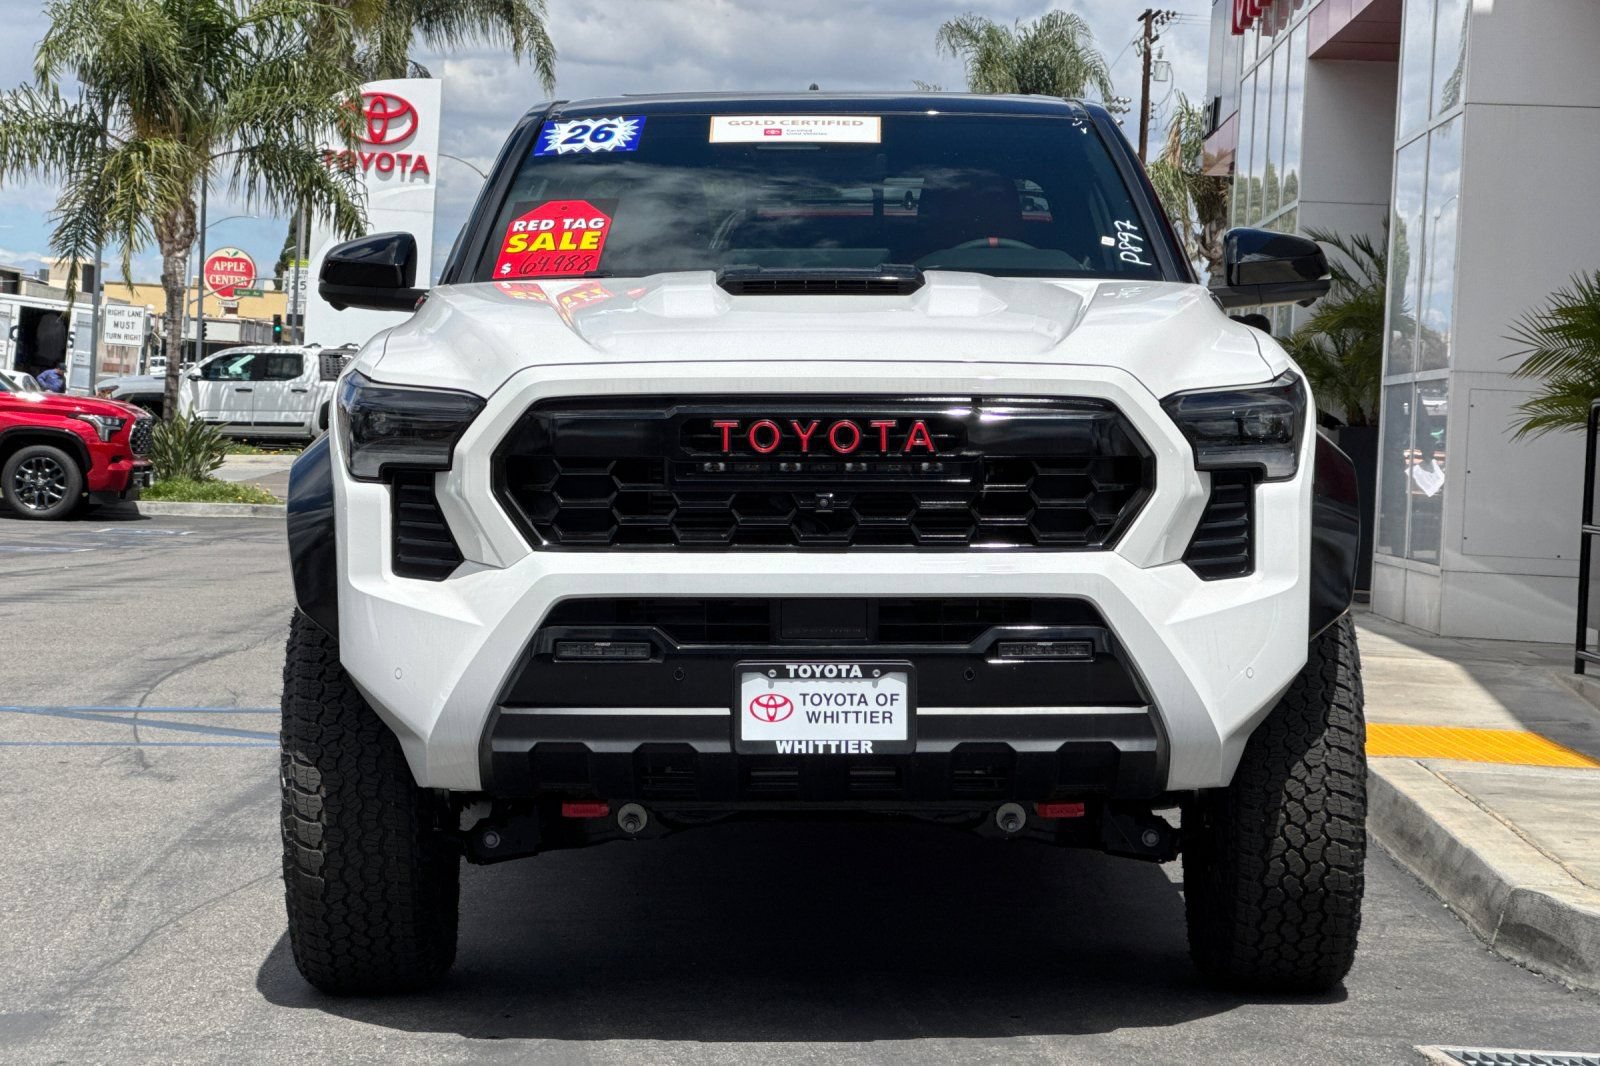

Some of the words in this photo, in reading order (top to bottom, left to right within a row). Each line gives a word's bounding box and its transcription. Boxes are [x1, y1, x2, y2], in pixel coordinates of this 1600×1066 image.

[559, 123, 619, 145] 26
[512, 219, 555, 232] RED
[562, 217, 605, 230] TAG
[505, 230, 601, 253] SALE
[213, 261, 246, 272] APPLE
[500, 260, 512, 274] $
[209, 274, 248, 286] CENTER
[107, 308, 125, 316] RIGHT
[128, 309, 142, 318] LANE
[113, 320, 136, 330] MUST
[105, 332, 122, 340] TURN
[123, 333, 142, 341] RIGHT
[712, 419, 936, 454] TOYOTA
[786, 664, 863, 678] TOYOTA
[799, 692, 869, 707] TOYOTA
[875, 692, 900, 707] OF
[805, 710, 894, 724] WHITTIER
[775, 740, 873, 754] WHITTIER
